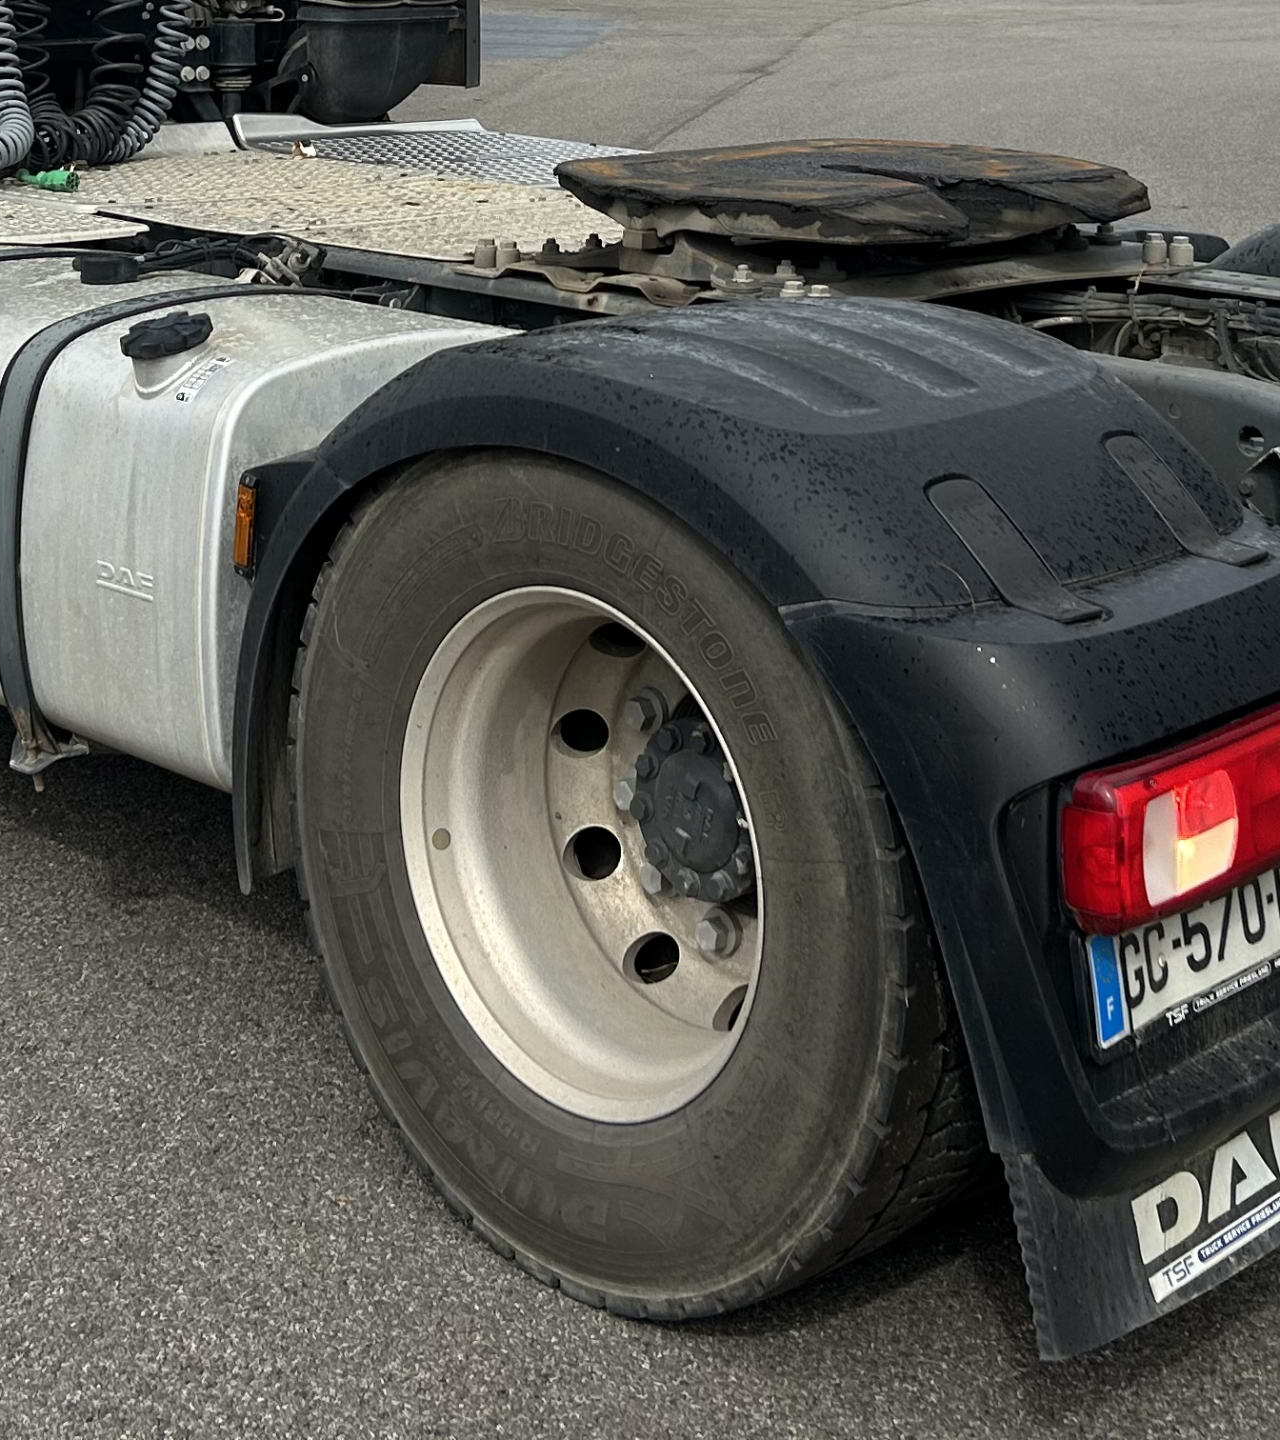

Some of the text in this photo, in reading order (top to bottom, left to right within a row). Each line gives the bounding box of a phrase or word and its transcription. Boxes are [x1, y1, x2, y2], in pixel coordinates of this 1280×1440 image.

[96, 559, 154, 589] DAF
[492, 495, 779, 747] BRIDGESTONE
[1105, 994, 1116, 1022] F
[1165, 1003, 1190, 1027] TSF
[1162, 1255, 1196, 1289] TSF
[1200, 1237, 1223, 1259] TRUCK
[1223, 1219, 1251, 1246] SERVICE
